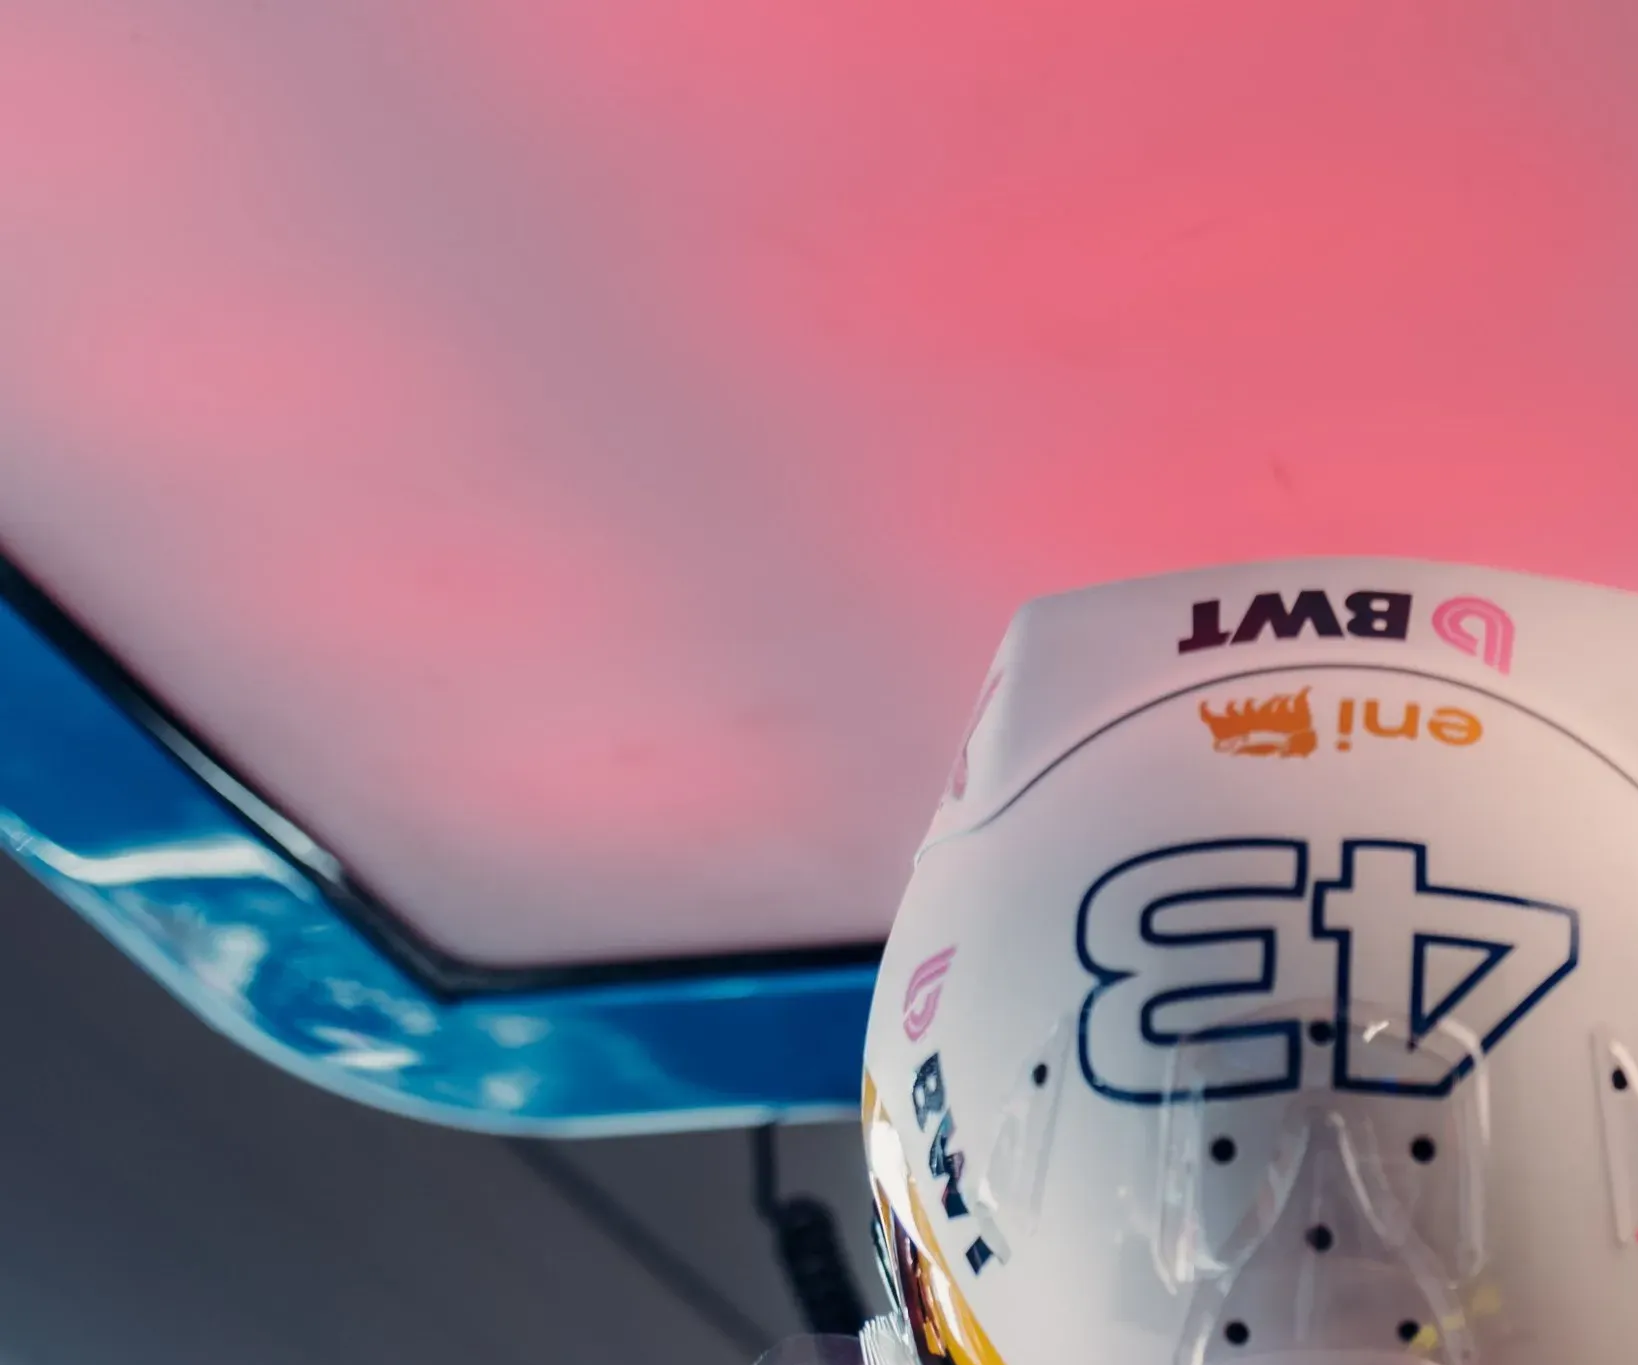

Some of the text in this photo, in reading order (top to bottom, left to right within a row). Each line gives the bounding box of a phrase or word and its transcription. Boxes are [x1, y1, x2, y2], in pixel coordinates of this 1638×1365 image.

[1178, 590, 1413, 655] BWT
[1337, 697, 1484, 753] eni
[1075, 838, 1580, 1106] 43
